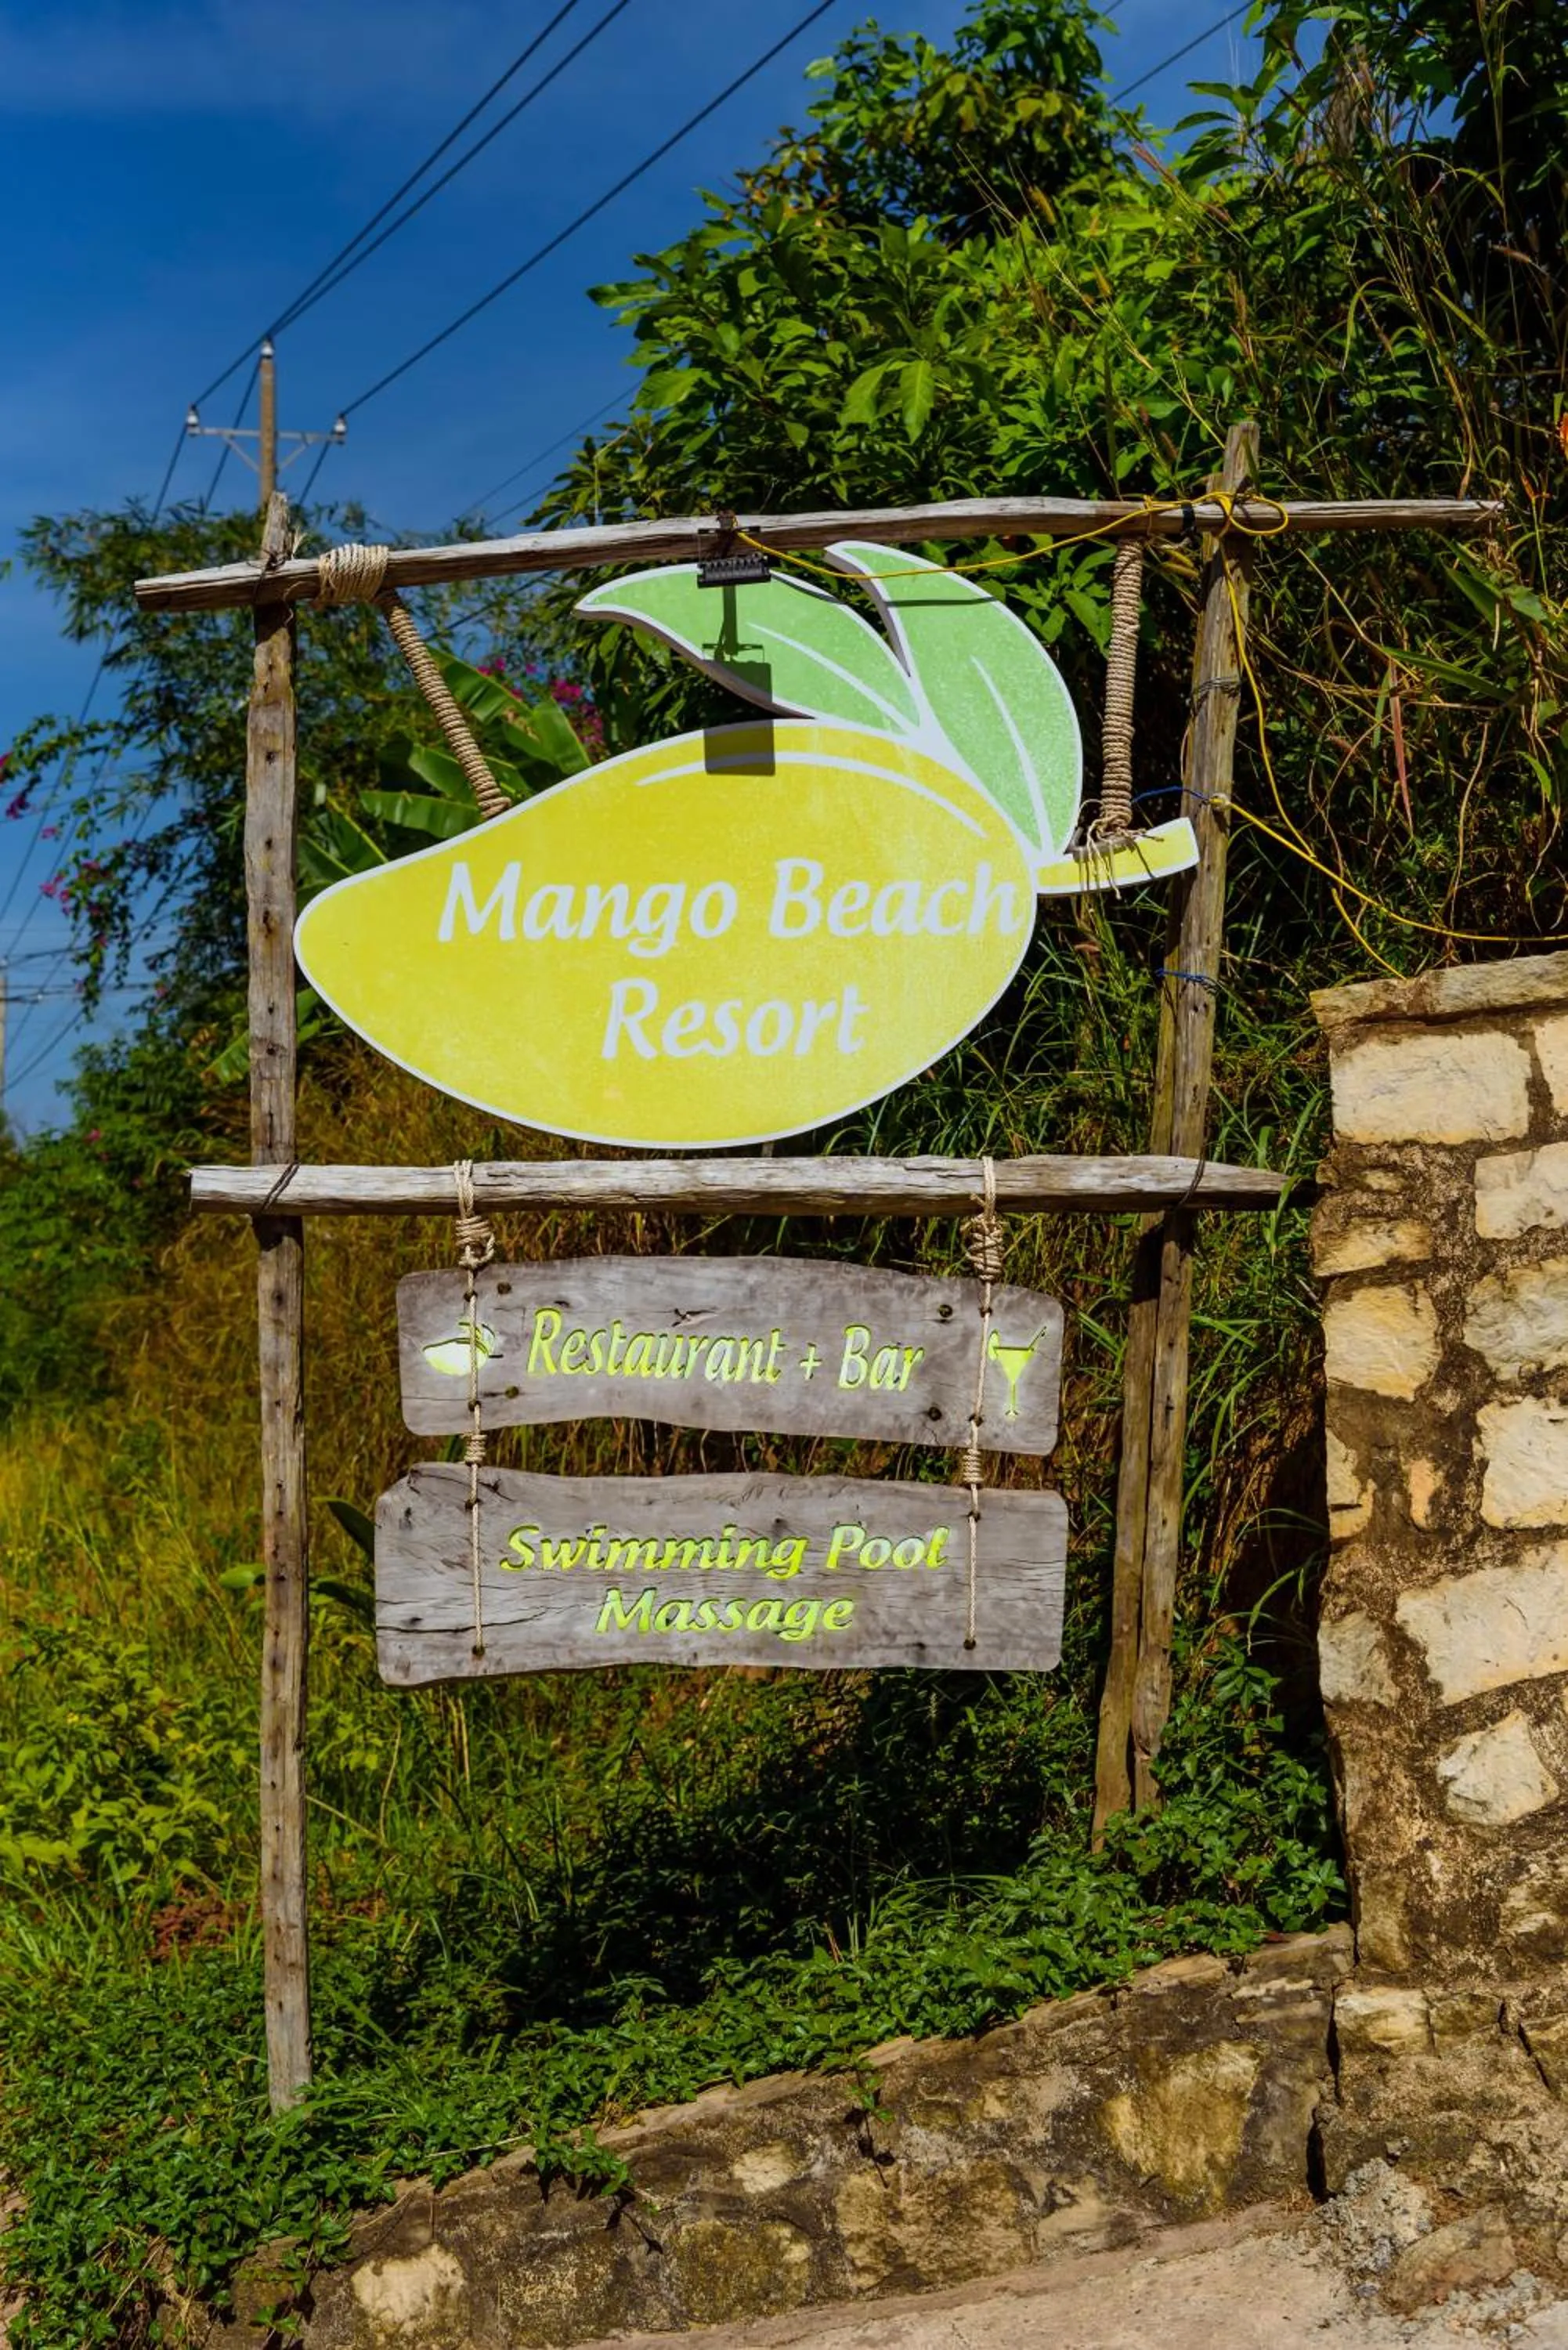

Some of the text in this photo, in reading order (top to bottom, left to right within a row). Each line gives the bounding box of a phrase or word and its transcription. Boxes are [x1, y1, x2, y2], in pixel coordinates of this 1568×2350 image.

[438, 858, 1021, 958] Mango Beach
[601, 977, 867, 1060] Resort
[527, 1307, 925, 1392] Restaurant + Bar
[499, 1521, 950, 1580] Swimming Pool
[594, 1587, 856, 1642] Massage
